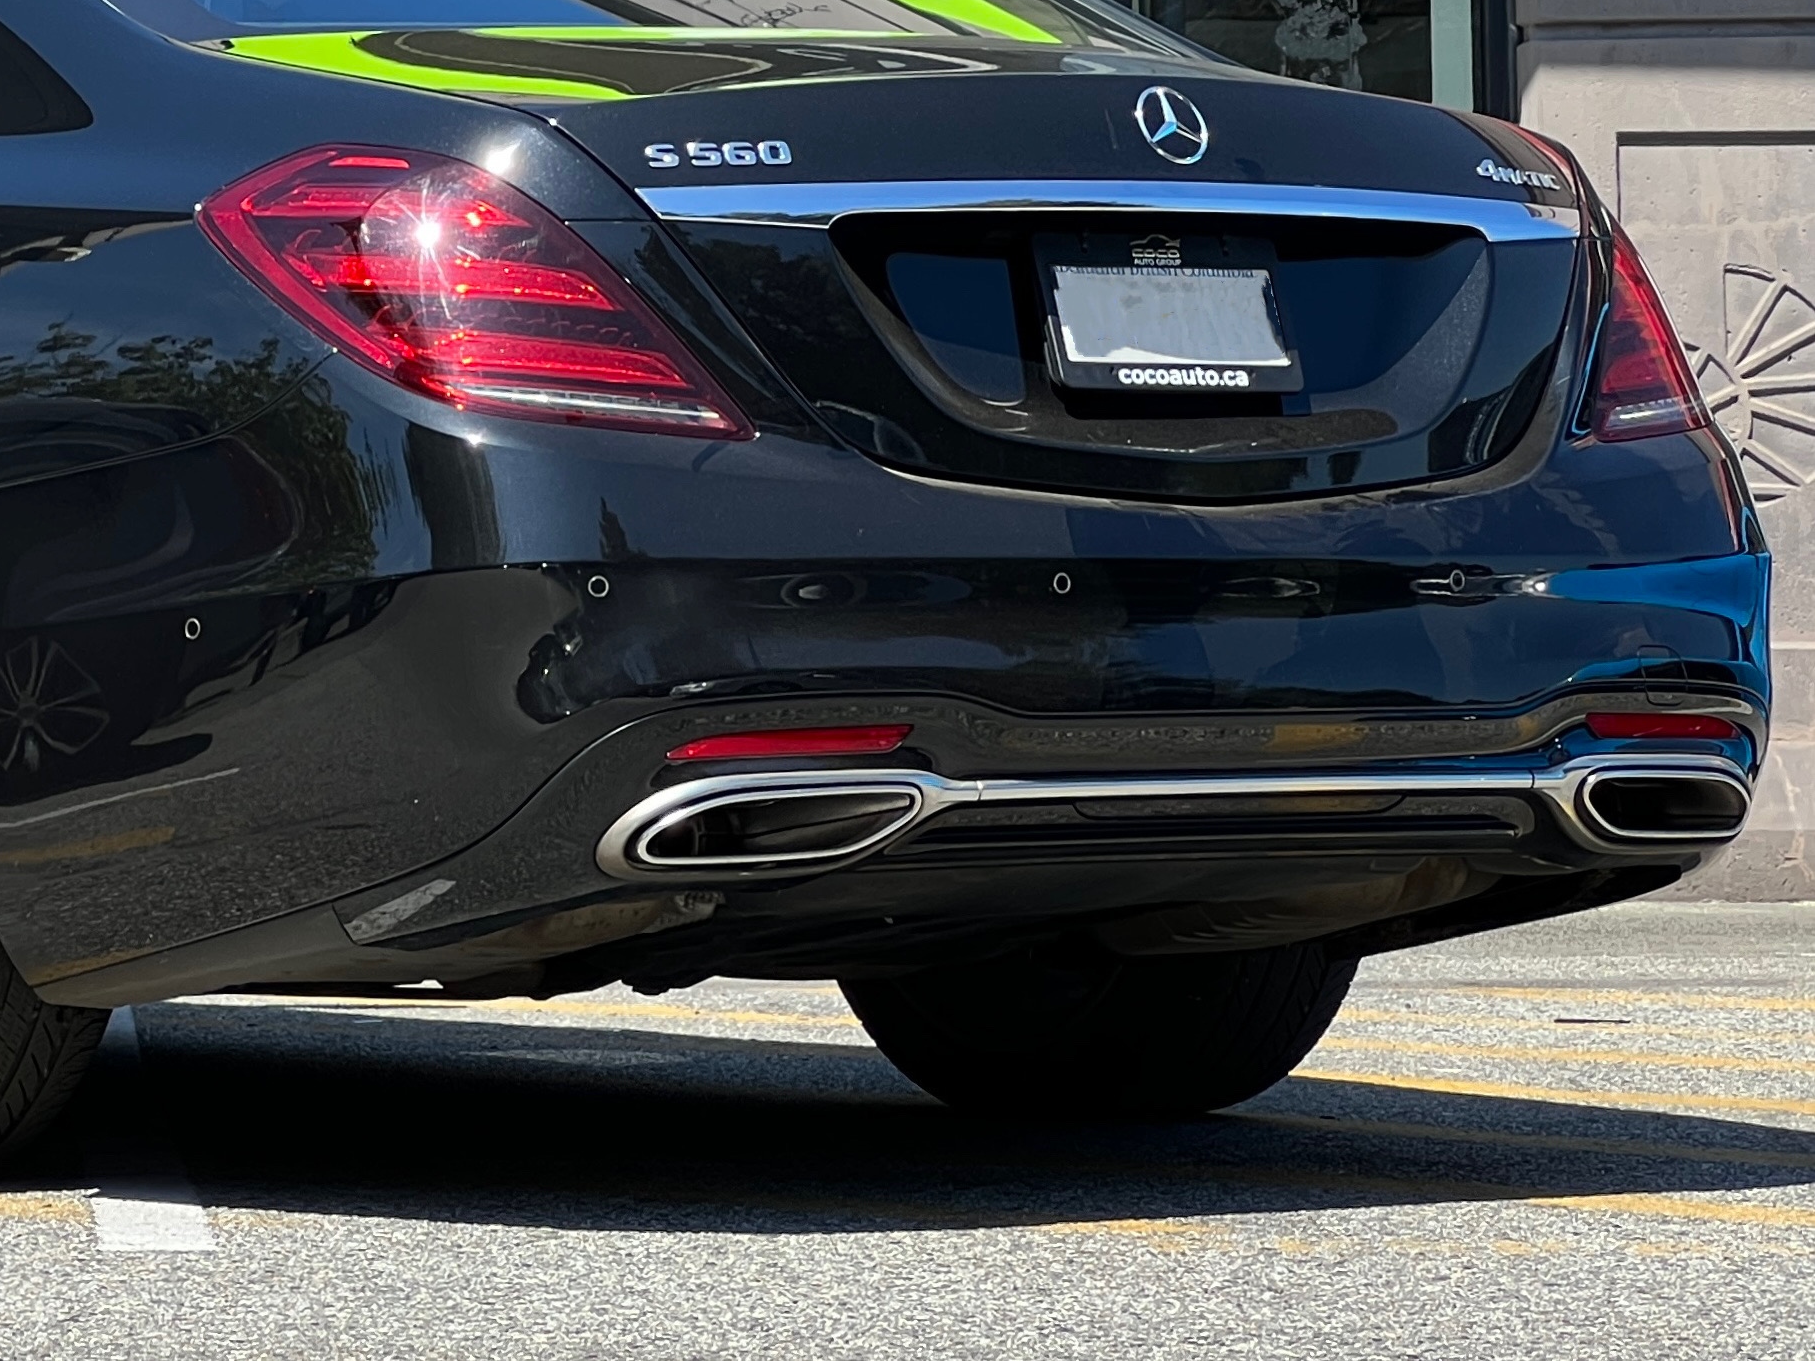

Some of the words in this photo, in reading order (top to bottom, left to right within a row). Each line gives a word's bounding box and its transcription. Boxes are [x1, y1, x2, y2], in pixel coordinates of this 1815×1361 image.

[644, 143, 680, 168] S
[686, 140, 792, 167] 560
[1134, 258, 1155, 266] AUTO
[1118, 366, 1250, 387] cocoauto.ca
